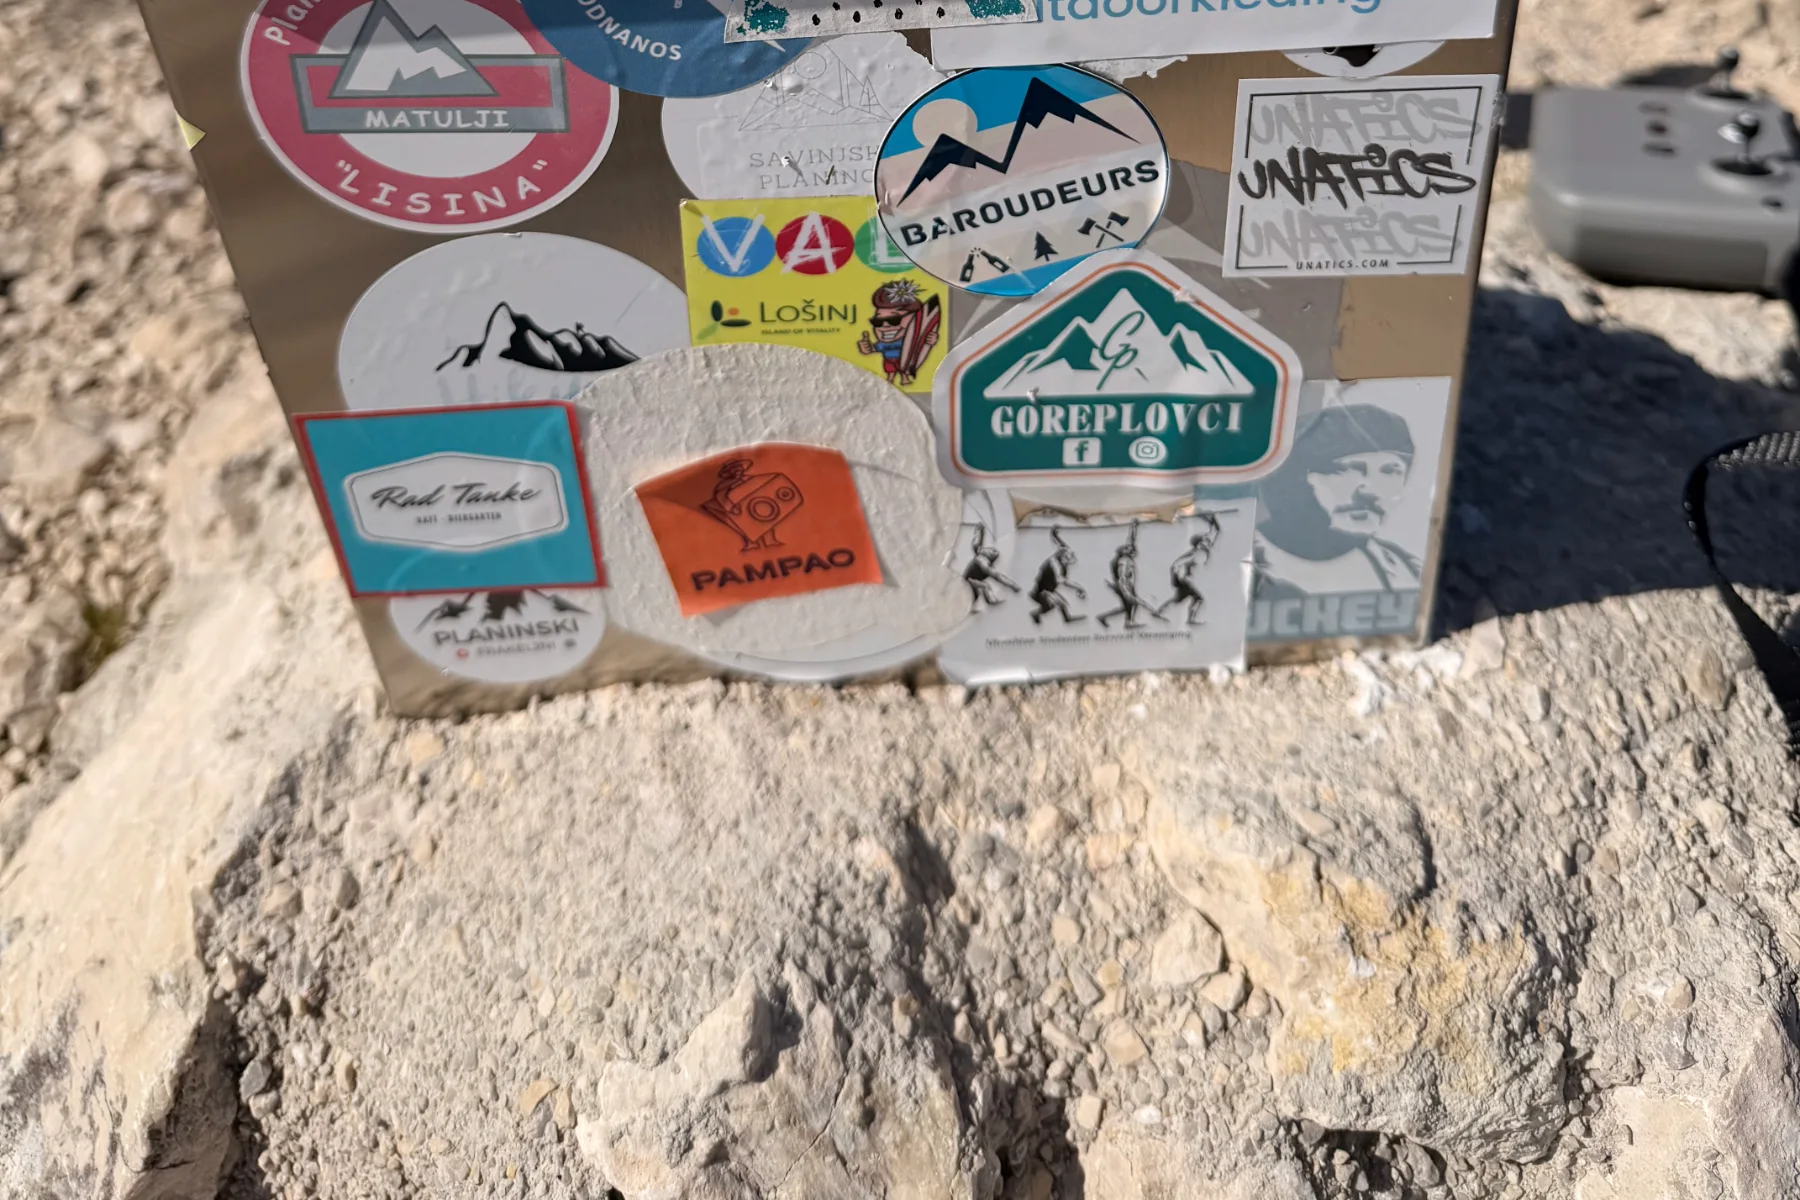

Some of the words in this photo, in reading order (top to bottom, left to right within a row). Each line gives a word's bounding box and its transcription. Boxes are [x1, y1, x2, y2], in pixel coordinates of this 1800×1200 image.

[364, 109, 510, 131] MATULJI
[902, 158, 1160, 247] BAROUDEURS
[1296, 258, 1390, 271] UNATICS.COM
[760, 298, 858, 325] LOŠINJ
[990, 401, 1244, 438] GOREPLOVCI
[370, 484, 446, 509] Rad
[451, 480, 543, 506] Tanke
[689, 547, 857, 592] PAMPAO
[433, 616, 580, 648] PLANINSKI
